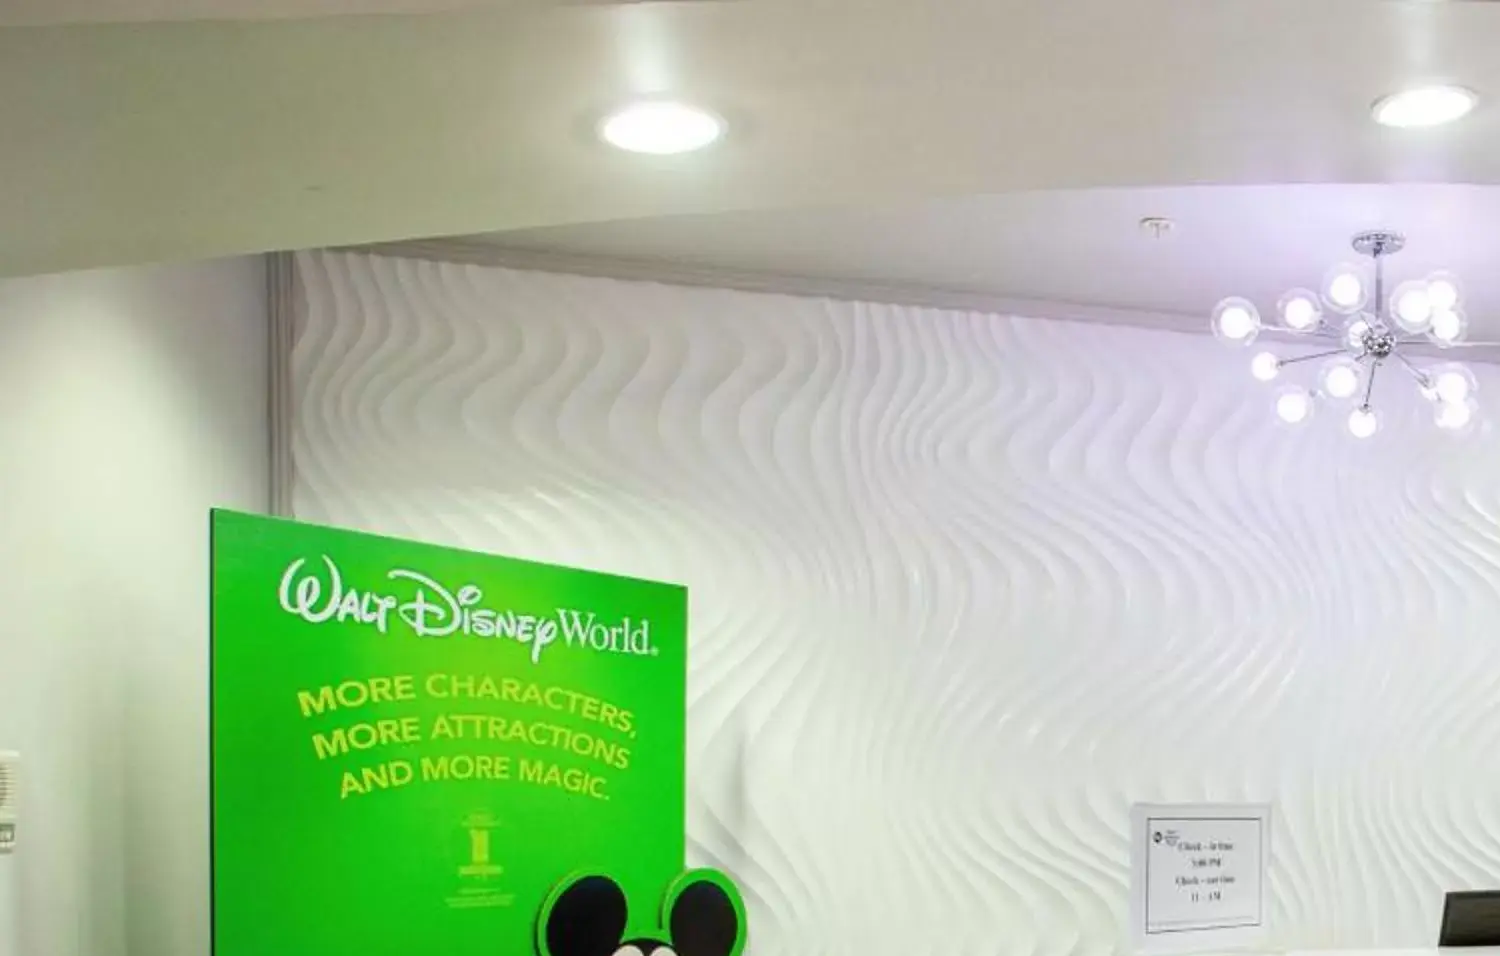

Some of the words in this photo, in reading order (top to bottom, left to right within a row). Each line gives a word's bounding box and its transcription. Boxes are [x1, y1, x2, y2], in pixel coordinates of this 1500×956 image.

[297, 674, 416, 718] MORE
[425, 673, 637, 739] CHARACTERS,
[312, 716, 421, 760] MORE
[430, 713, 631, 770] ATTRACTIONS
[340, 759, 414, 800] AND
[419, 754, 511, 782] MORE
[519, 758, 610, 801] MAGIC.
